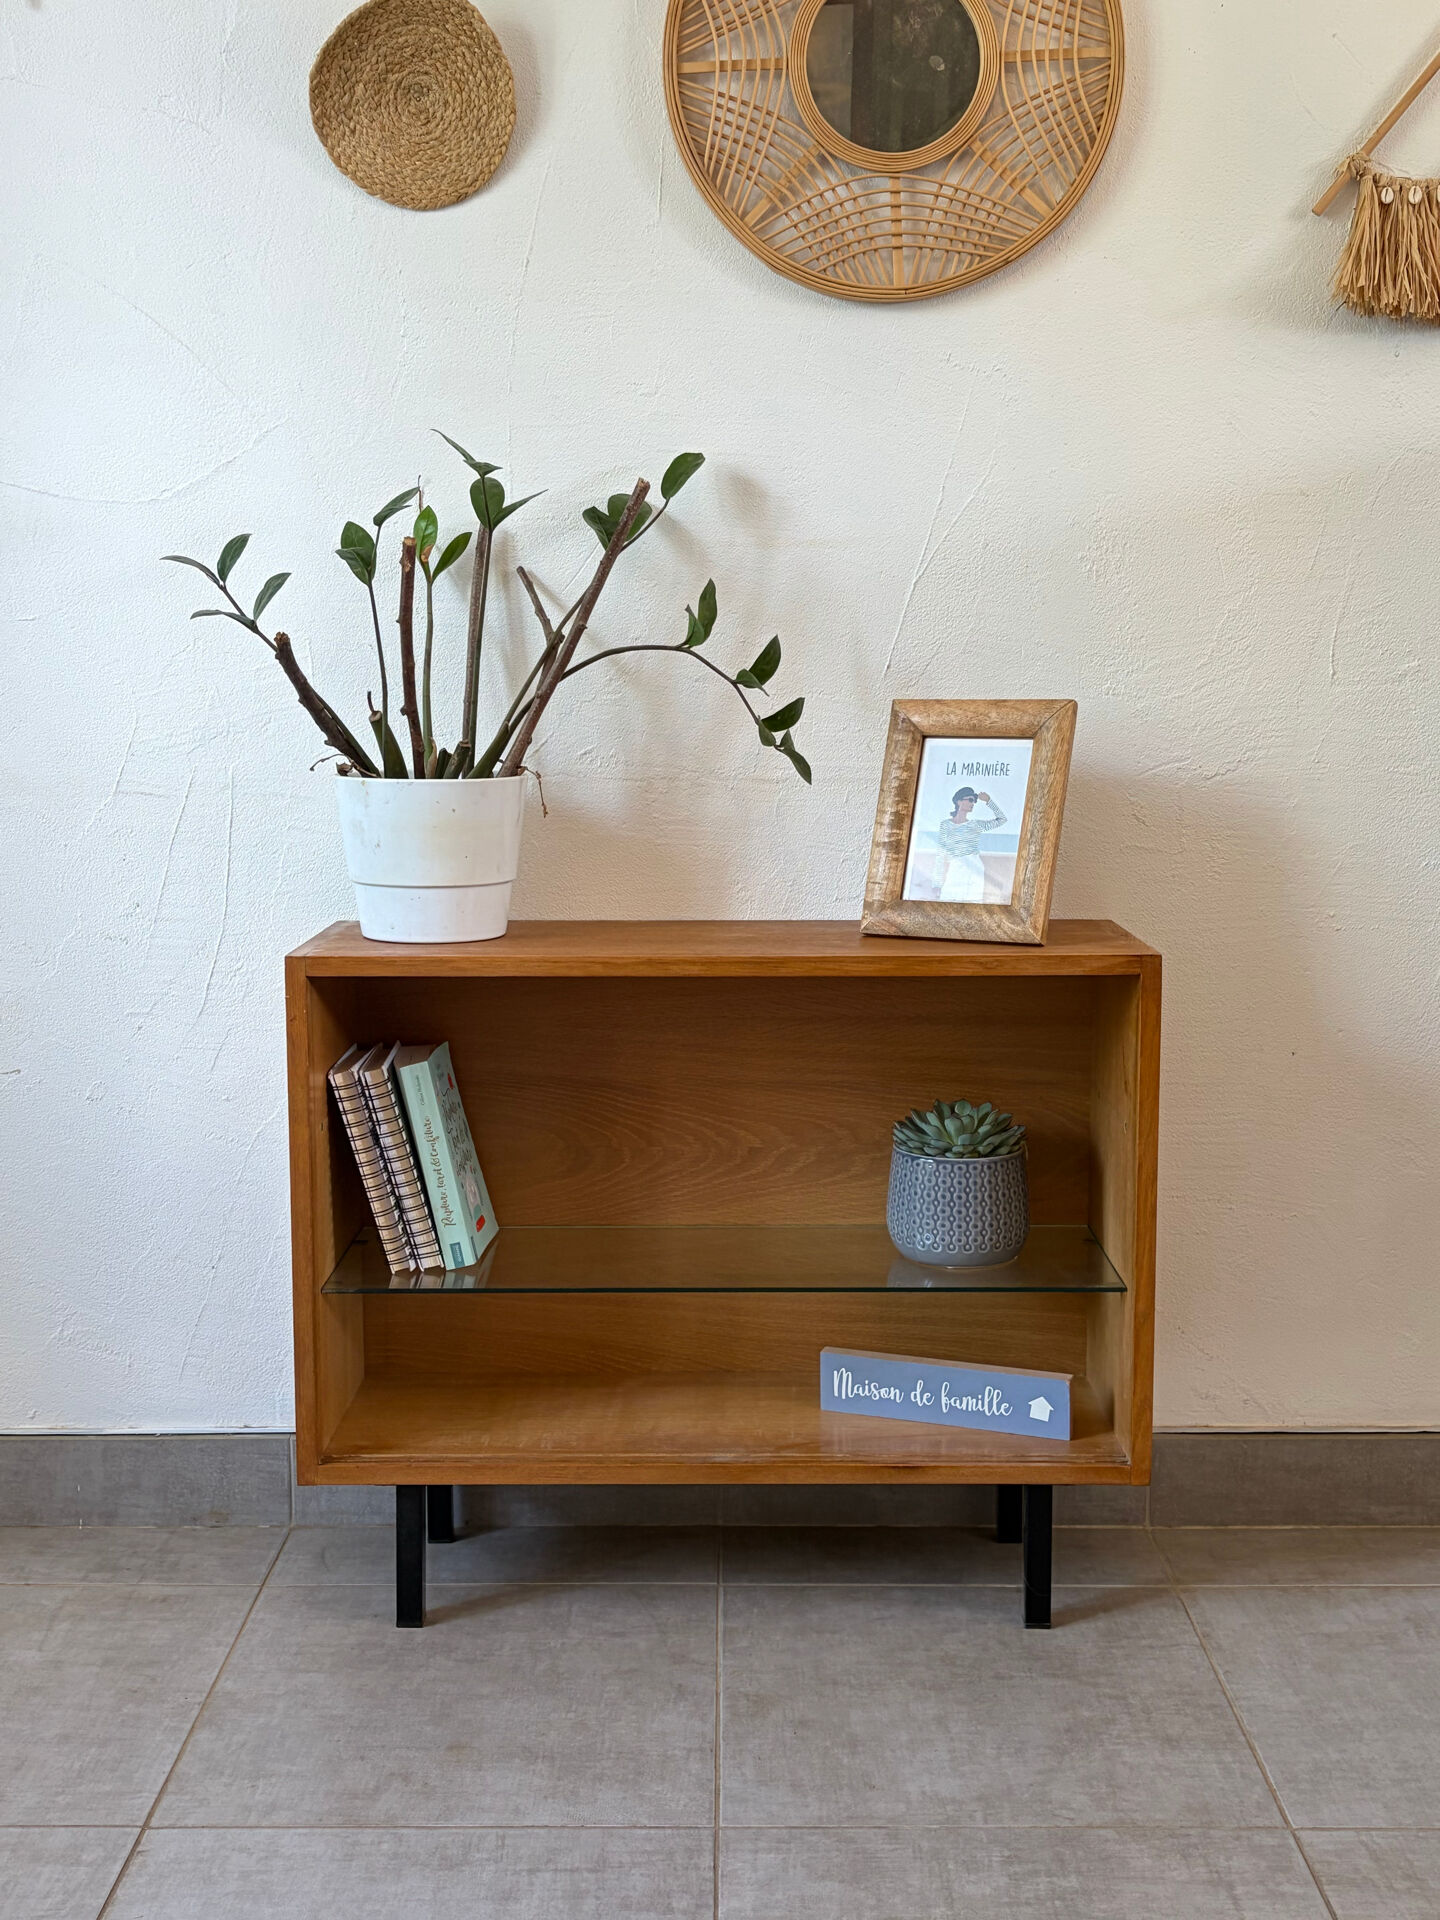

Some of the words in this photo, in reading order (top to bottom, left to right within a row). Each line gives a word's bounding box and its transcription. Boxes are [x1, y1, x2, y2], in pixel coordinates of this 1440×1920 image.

[946, 761, 957, 776] LA
[961, 760, 1011, 777] MARINIÈRE
[833, 1367, 904, 1404] Maison
[910, 1379, 935, 1407] de
[940, 1381, 1013, 1417] famille
